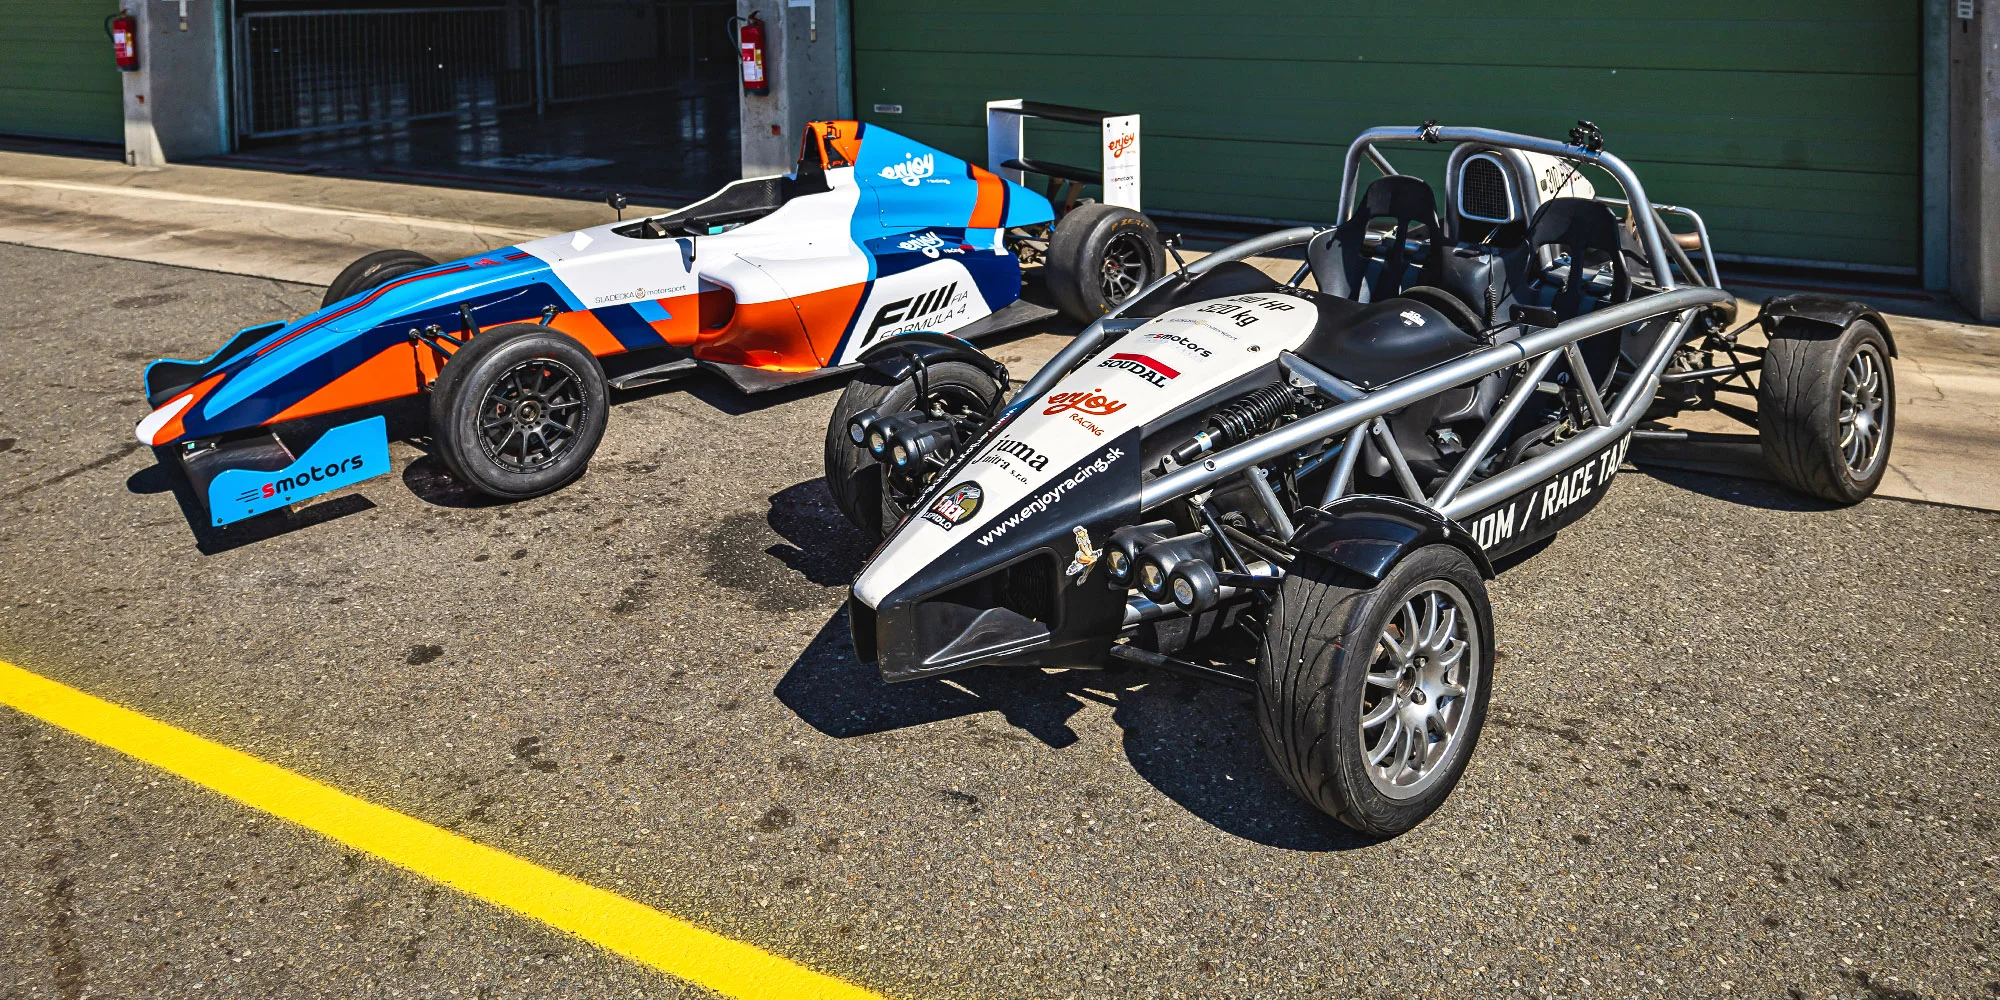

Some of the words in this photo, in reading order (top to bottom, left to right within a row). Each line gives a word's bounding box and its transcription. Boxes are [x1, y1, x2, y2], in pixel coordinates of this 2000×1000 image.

[1108, 132, 1135, 158] enjoy
[877, 152, 935, 187] enjoy
[896, 231, 945, 259] enjoy
[951, 290, 968, 305] FIA
[1258, 300, 1296, 312] HP
[879, 310, 953, 342] FORMULA
[957, 303, 967, 314] 4
[1230, 310, 1259, 327] kg
[1153, 333, 1213, 358] smotors
[1097, 359, 1167, 388] SOUDAL
[1042, 388, 1127, 415] enjoy
[1069, 413, 1105, 437] RACING
[260, 454, 364, 498] smotors
[1009, 469, 1028, 485] s.r.o.
[977, 447, 1125, 547] www.enjoyracing.sk
[1540, 459, 1596, 521] RACE
